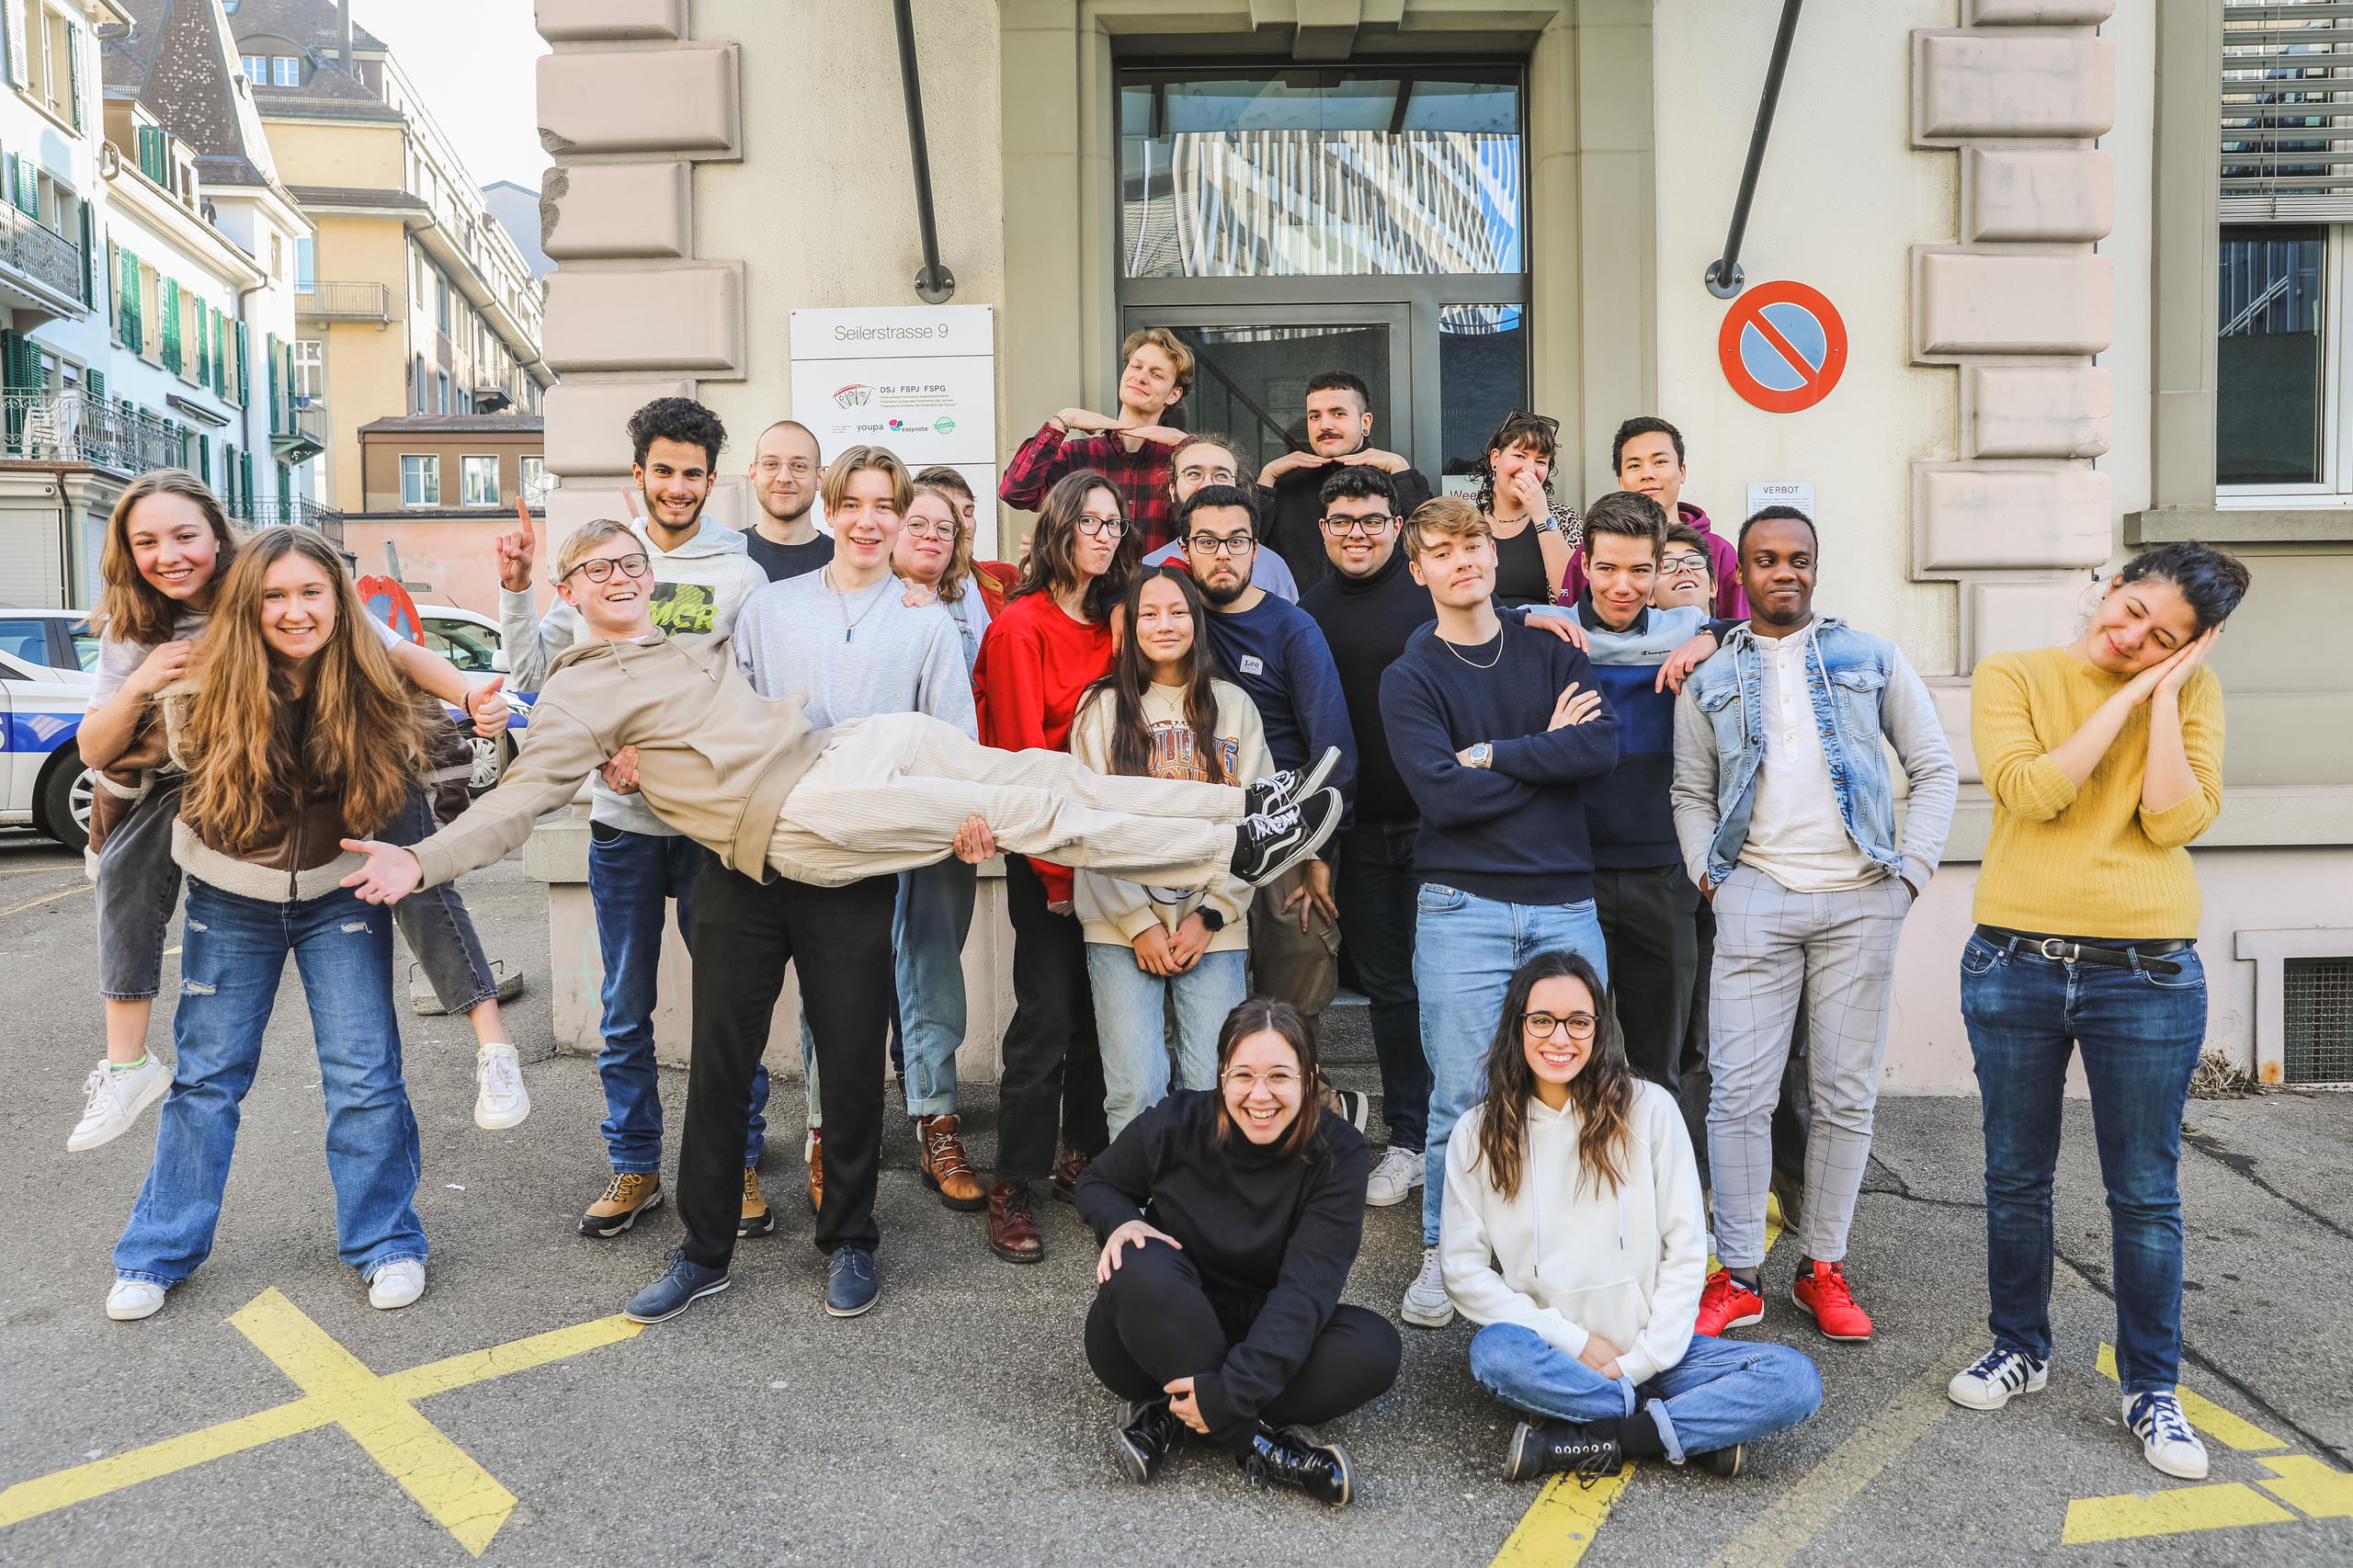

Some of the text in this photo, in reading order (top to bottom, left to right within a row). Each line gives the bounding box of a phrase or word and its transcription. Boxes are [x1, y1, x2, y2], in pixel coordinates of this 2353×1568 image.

[835, 323, 949, 341] Seilerstrasse 9
[900, 385, 920, 393] FSPJ
[924, 384, 946, 392] FSPG
[857, 424, 884, 433] youpa
[1763, 485, 1800, 494] VERBOT
[1244, 660, 1259, 668] Lee
